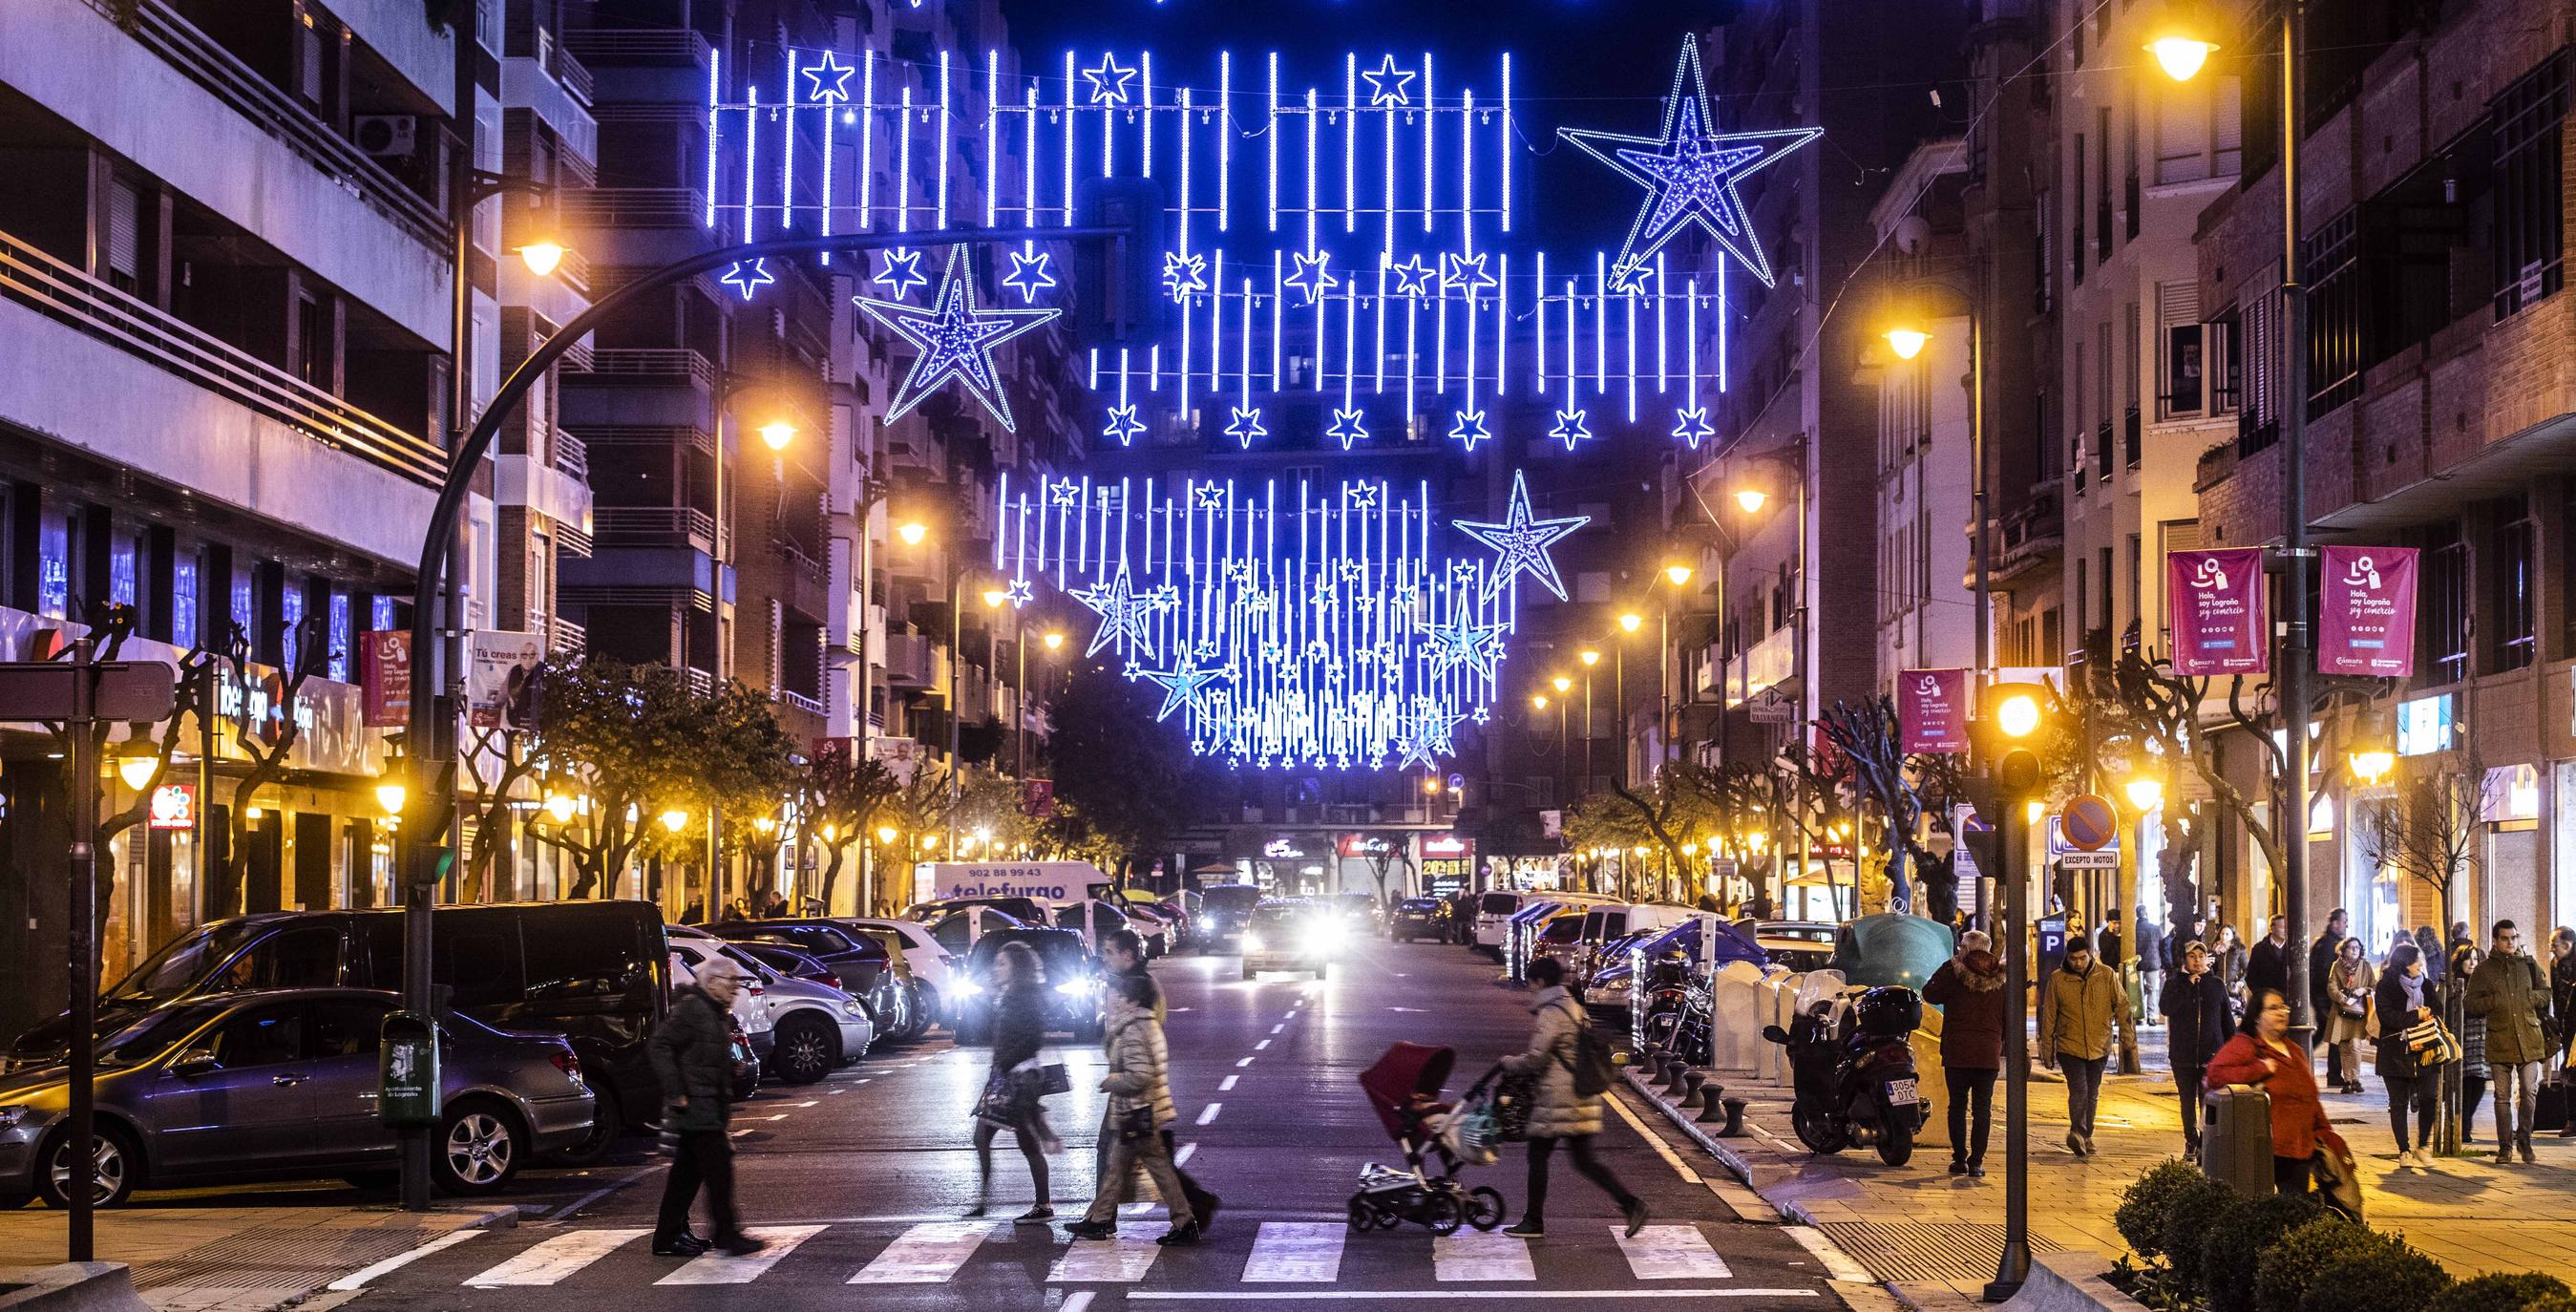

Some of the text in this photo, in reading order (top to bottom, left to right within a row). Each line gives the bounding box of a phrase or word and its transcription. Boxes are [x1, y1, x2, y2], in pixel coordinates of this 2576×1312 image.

[2351, 589, 2368, 598] Hola,
[2211, 599, 2239, 608] Logroño
[2363, 598, 2391, 606] Logroño
[475, 648, 517, 660] Tú creas
[2064, 856, 2113, 864] EXCEPTO MOTOS
[969, 868, 1042, 878] 902 88 99 43
[2046, 935, 2059, 951] P
[1892, 1080, 1915, 1090] 3054
[1897, 1090, 1915, 1100] DTC
